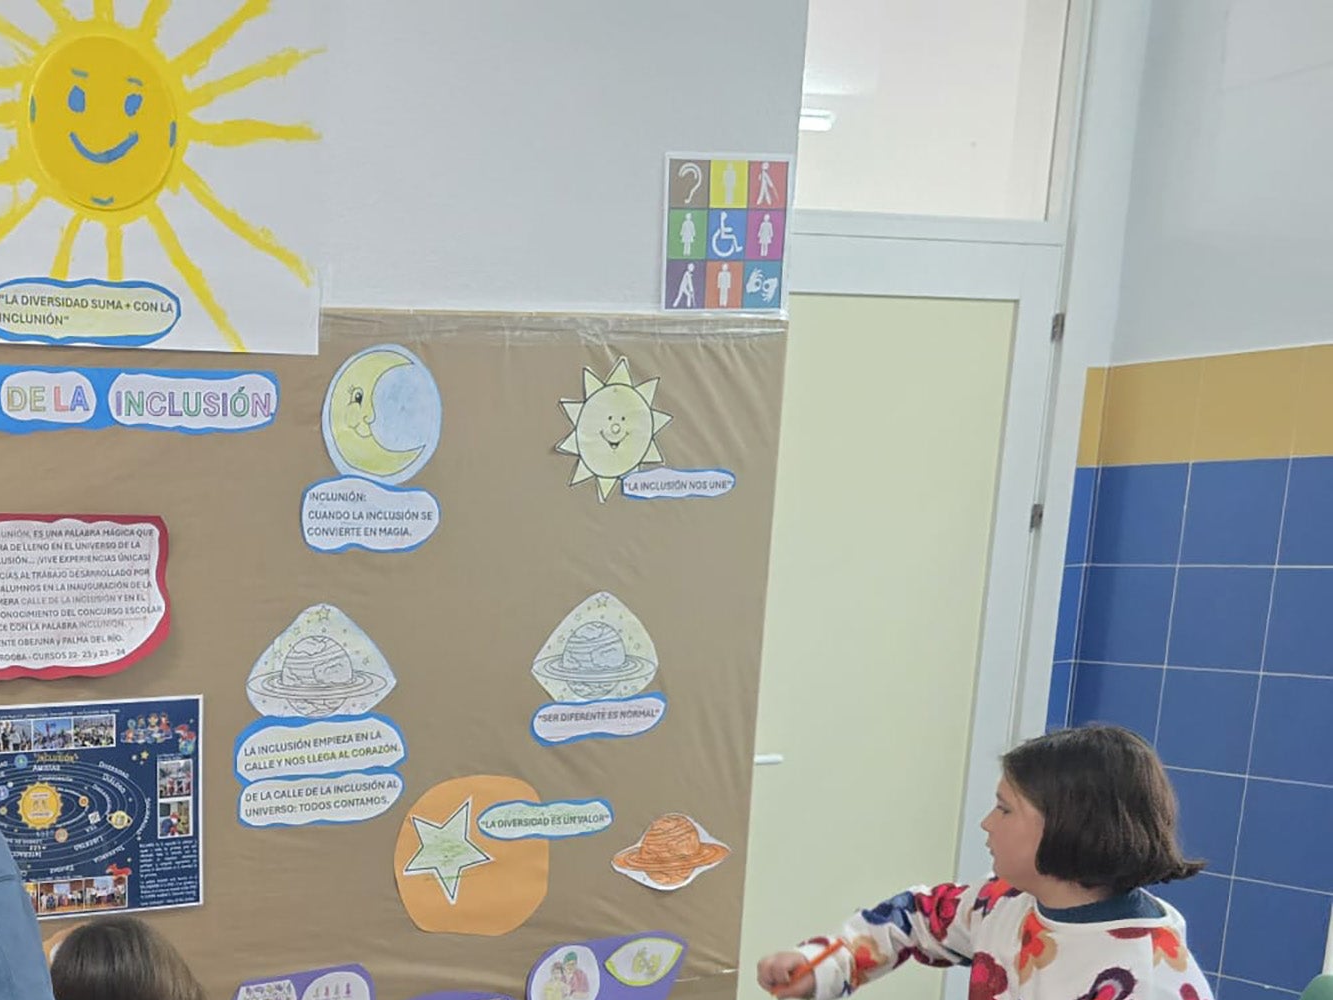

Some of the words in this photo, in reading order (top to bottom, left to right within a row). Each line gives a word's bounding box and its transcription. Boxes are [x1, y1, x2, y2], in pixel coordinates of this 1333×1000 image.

[21, 295, 88, 308] DIVERSIDAD
[92, 300, 122, 309] SUMA
[134, 302, 158, 312] CON
[160, 302, 173, 313] LA
[7, 386, 45, 412] DE
[54, 385, 89, 412] LA
[116, 386, 271, 418] INCLUSIÓN
[641, 480, 687, 490] INCLUSIÓN
[689, 481, 707, 489] NOS
[308, 511, 350, 520] CUANDO
[352, 511, 364, 520] LA
[366, 510, 419, 520] INCLUSIÓN
[421, 511, 432, 520] SE
[307, 528, 361, 536] CONVIERTE
[364, 528, 376, 536] EN
[561, 711, 605, 721] DIFERENTE
[608, 711, 618, 719] ES
[244, 747, 256, 756] LA
[258, 740, 311, 754] INCLUSIÓN
[313, 735, 353, 747] EMPIEZA
[356, 733, 368, 742] EN
[370, 731, 381, 740] LA
[245, 761, 274, 772] CALLE
[277, 760, 283, 768] Y
[285, 756, 305, 766] NOS
[307, 753, 336, 764] LLEGA
[339, 751, 350, 760] AL
[246, 792, 256, 802] DE
[260, 790, 271, 800] LA
[274, 788, 303, 799] CALLE
[306, 787, 318, 796] DE
[320, 785, 331, 794] LA
[333, 781, 385, 793] INCLUSIÓN
[386, 780, 398, 788] AL
[299, 802, 331, 811] TODOS
[498, 816, 549, 827] DIVERSIDAD
[551, 816, 561, 825] ES
[563, 816, 575, 824] UN
